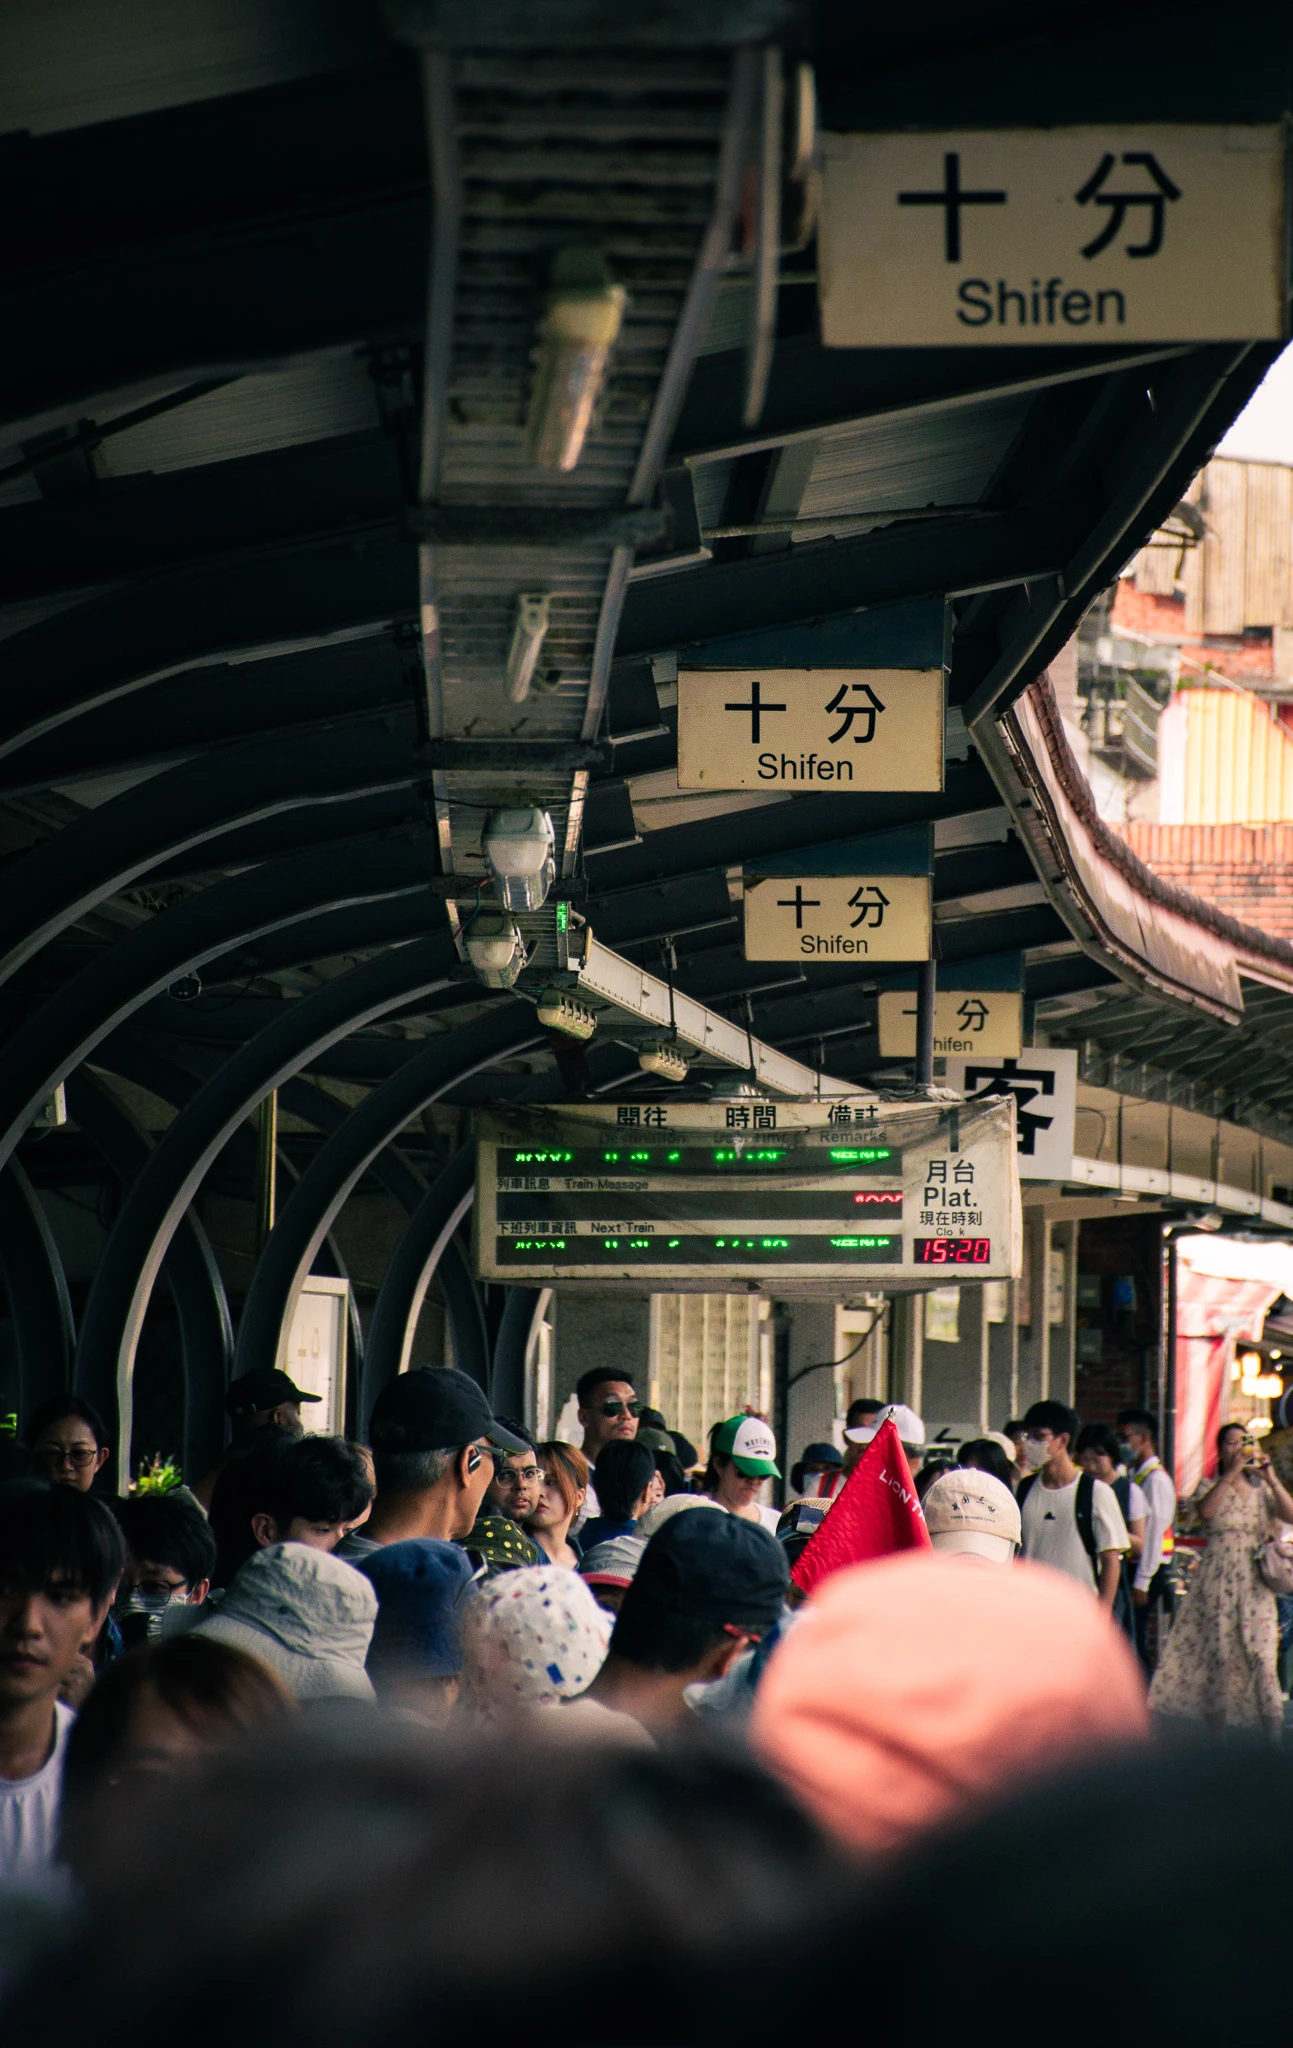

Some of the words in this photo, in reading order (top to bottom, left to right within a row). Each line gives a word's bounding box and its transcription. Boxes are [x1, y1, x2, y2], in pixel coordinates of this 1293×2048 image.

[897, 152, 1182, 263] 十分
[956, 277, 1127, 327] Shifen
[725, 682, 886, 744] 十分
[757, 753, 853, 780] Shifen
[777, 885, 890, 929] 十分
[800, 935, 868, 954] Shifen
[933, 1038, 973, 1052] hifen
[617, 1107, 668, 1129] 開往
[726, 1106, 776, 1129] 時間
[820, 1130, 888, 1142] Remarks
[926, 1159, 975, 1184] 月台
[497, 1178, 551, 1190] 列車訊息
[565, 1179, 594, 1190] Train
[598, 1179, 649, 1191] Message
[924, 1187, 978, 1207] Plat.
[499, 1222, 577, 1234] 下班列車資訊
[591, 1223, 621, 1233] Next
[626, 1223, 655, 1233] Train
[920, 1211, 982, 1226] 現在時刻
[923, 1239, 990, 1263] 15:20
[879, 1469, 912, 1504] LION
